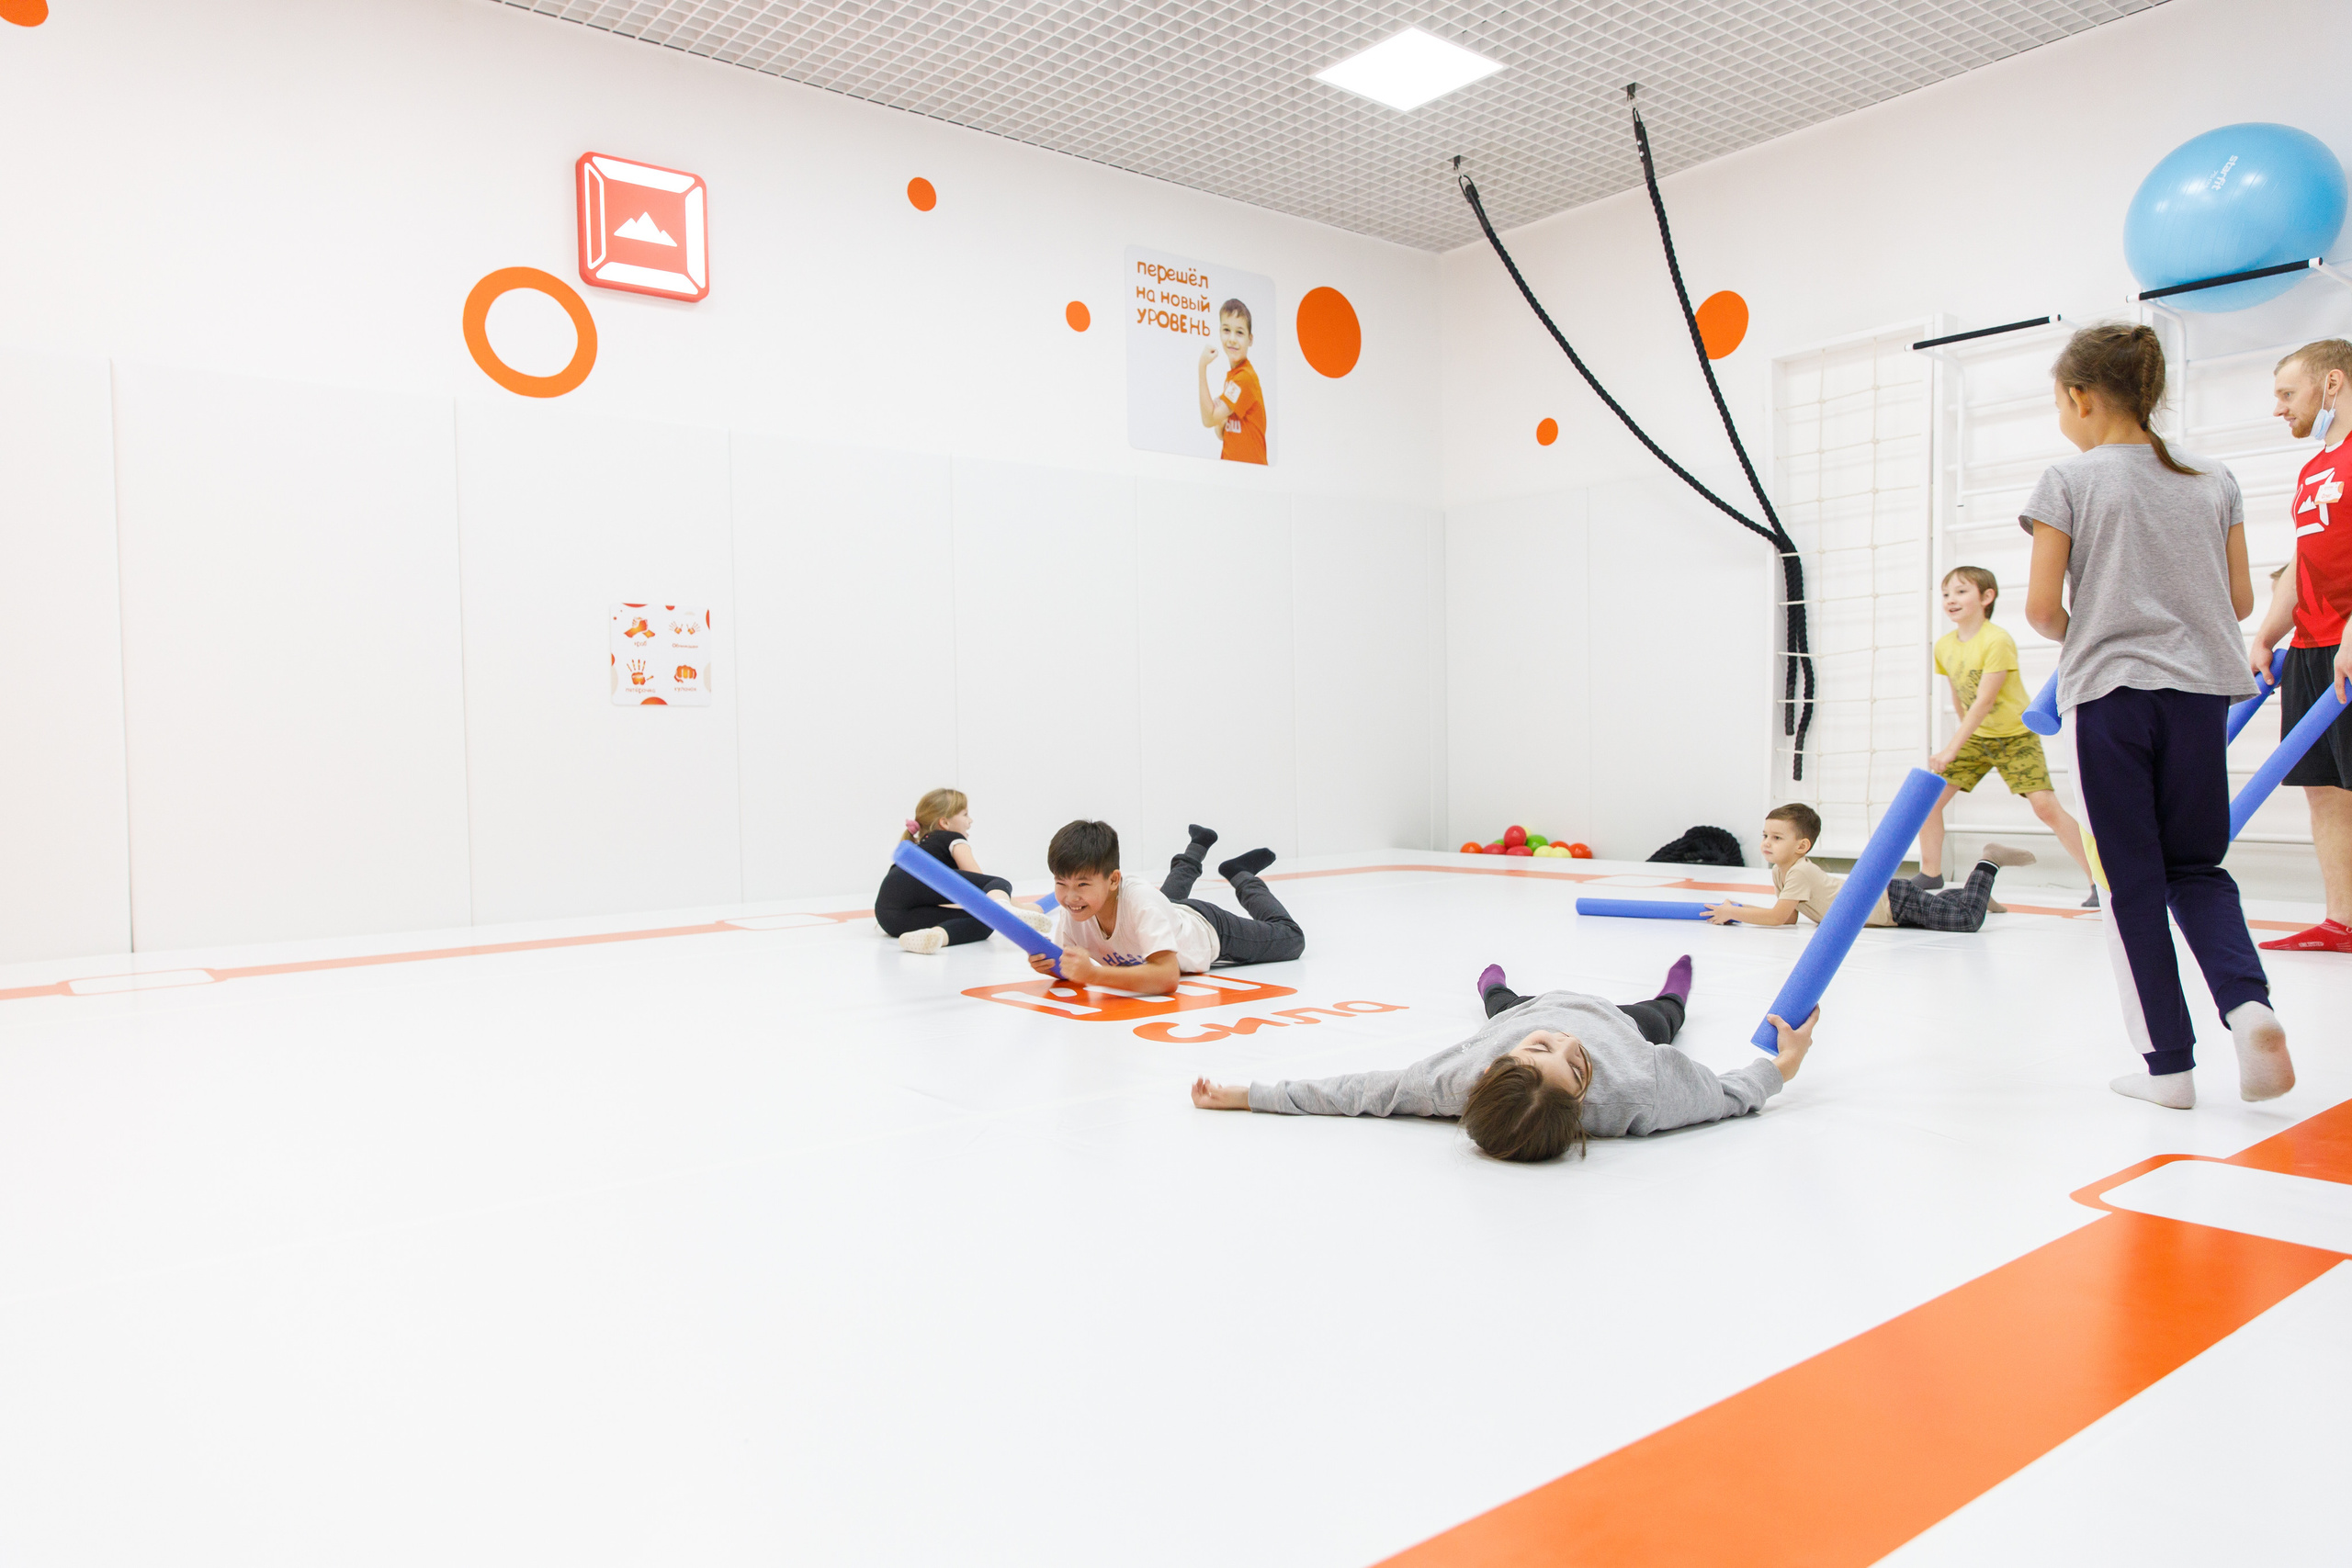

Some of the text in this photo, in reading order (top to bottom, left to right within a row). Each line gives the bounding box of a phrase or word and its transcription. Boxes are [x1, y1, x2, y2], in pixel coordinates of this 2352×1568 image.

[2211, 155, 2238, 190] starfit
[1137, 261, 1208, 288] перешёл
[1136, 286, 1210, 312] на новый
[1133, 1000, 1409, 1043] Сила
